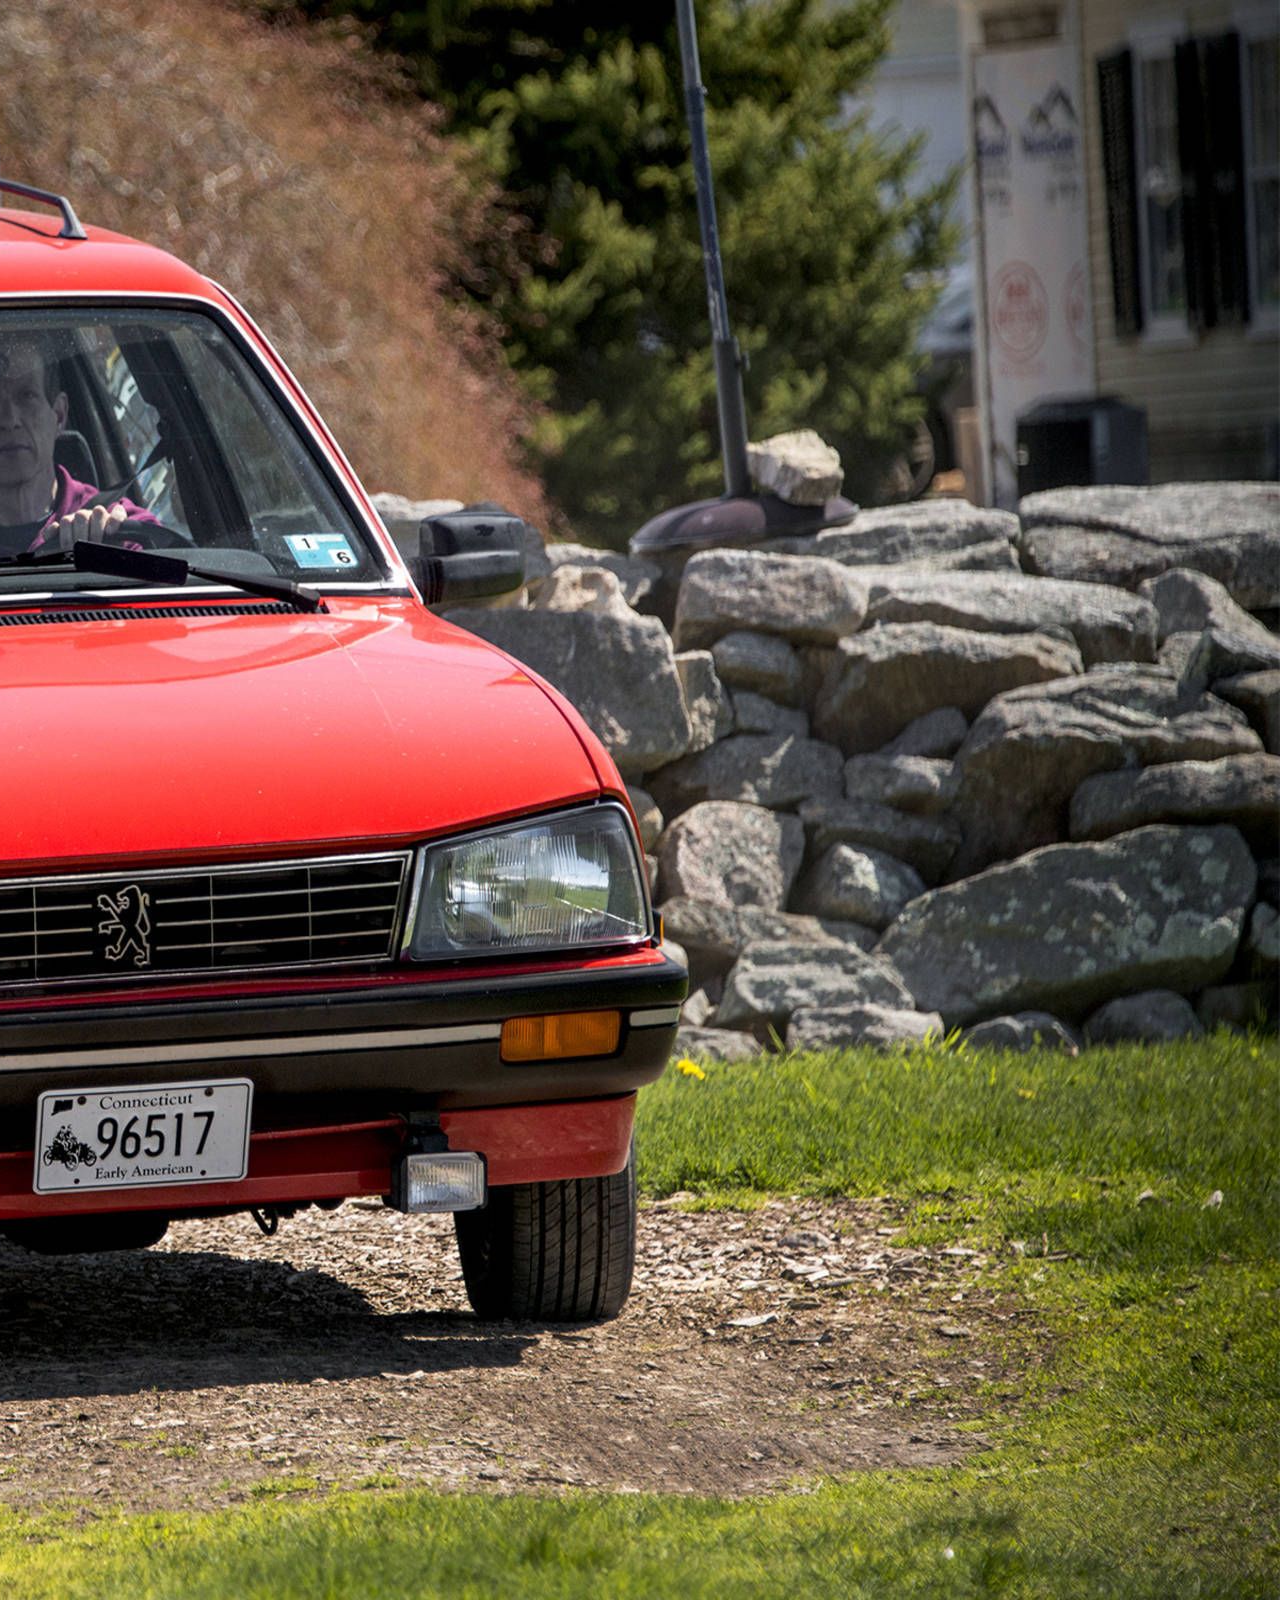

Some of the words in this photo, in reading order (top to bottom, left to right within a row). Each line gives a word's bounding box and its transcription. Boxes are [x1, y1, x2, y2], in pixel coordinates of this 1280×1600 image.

[301, 538, 311, 549] 1
[336, 552, 351, 564] 6
[100, 1093, 193, 1110] Connecticut
[97, 1111, 215, 1161] 96517
[95, 1166, 128, 1180] Early
[131, 1164, 194, 1178] American
